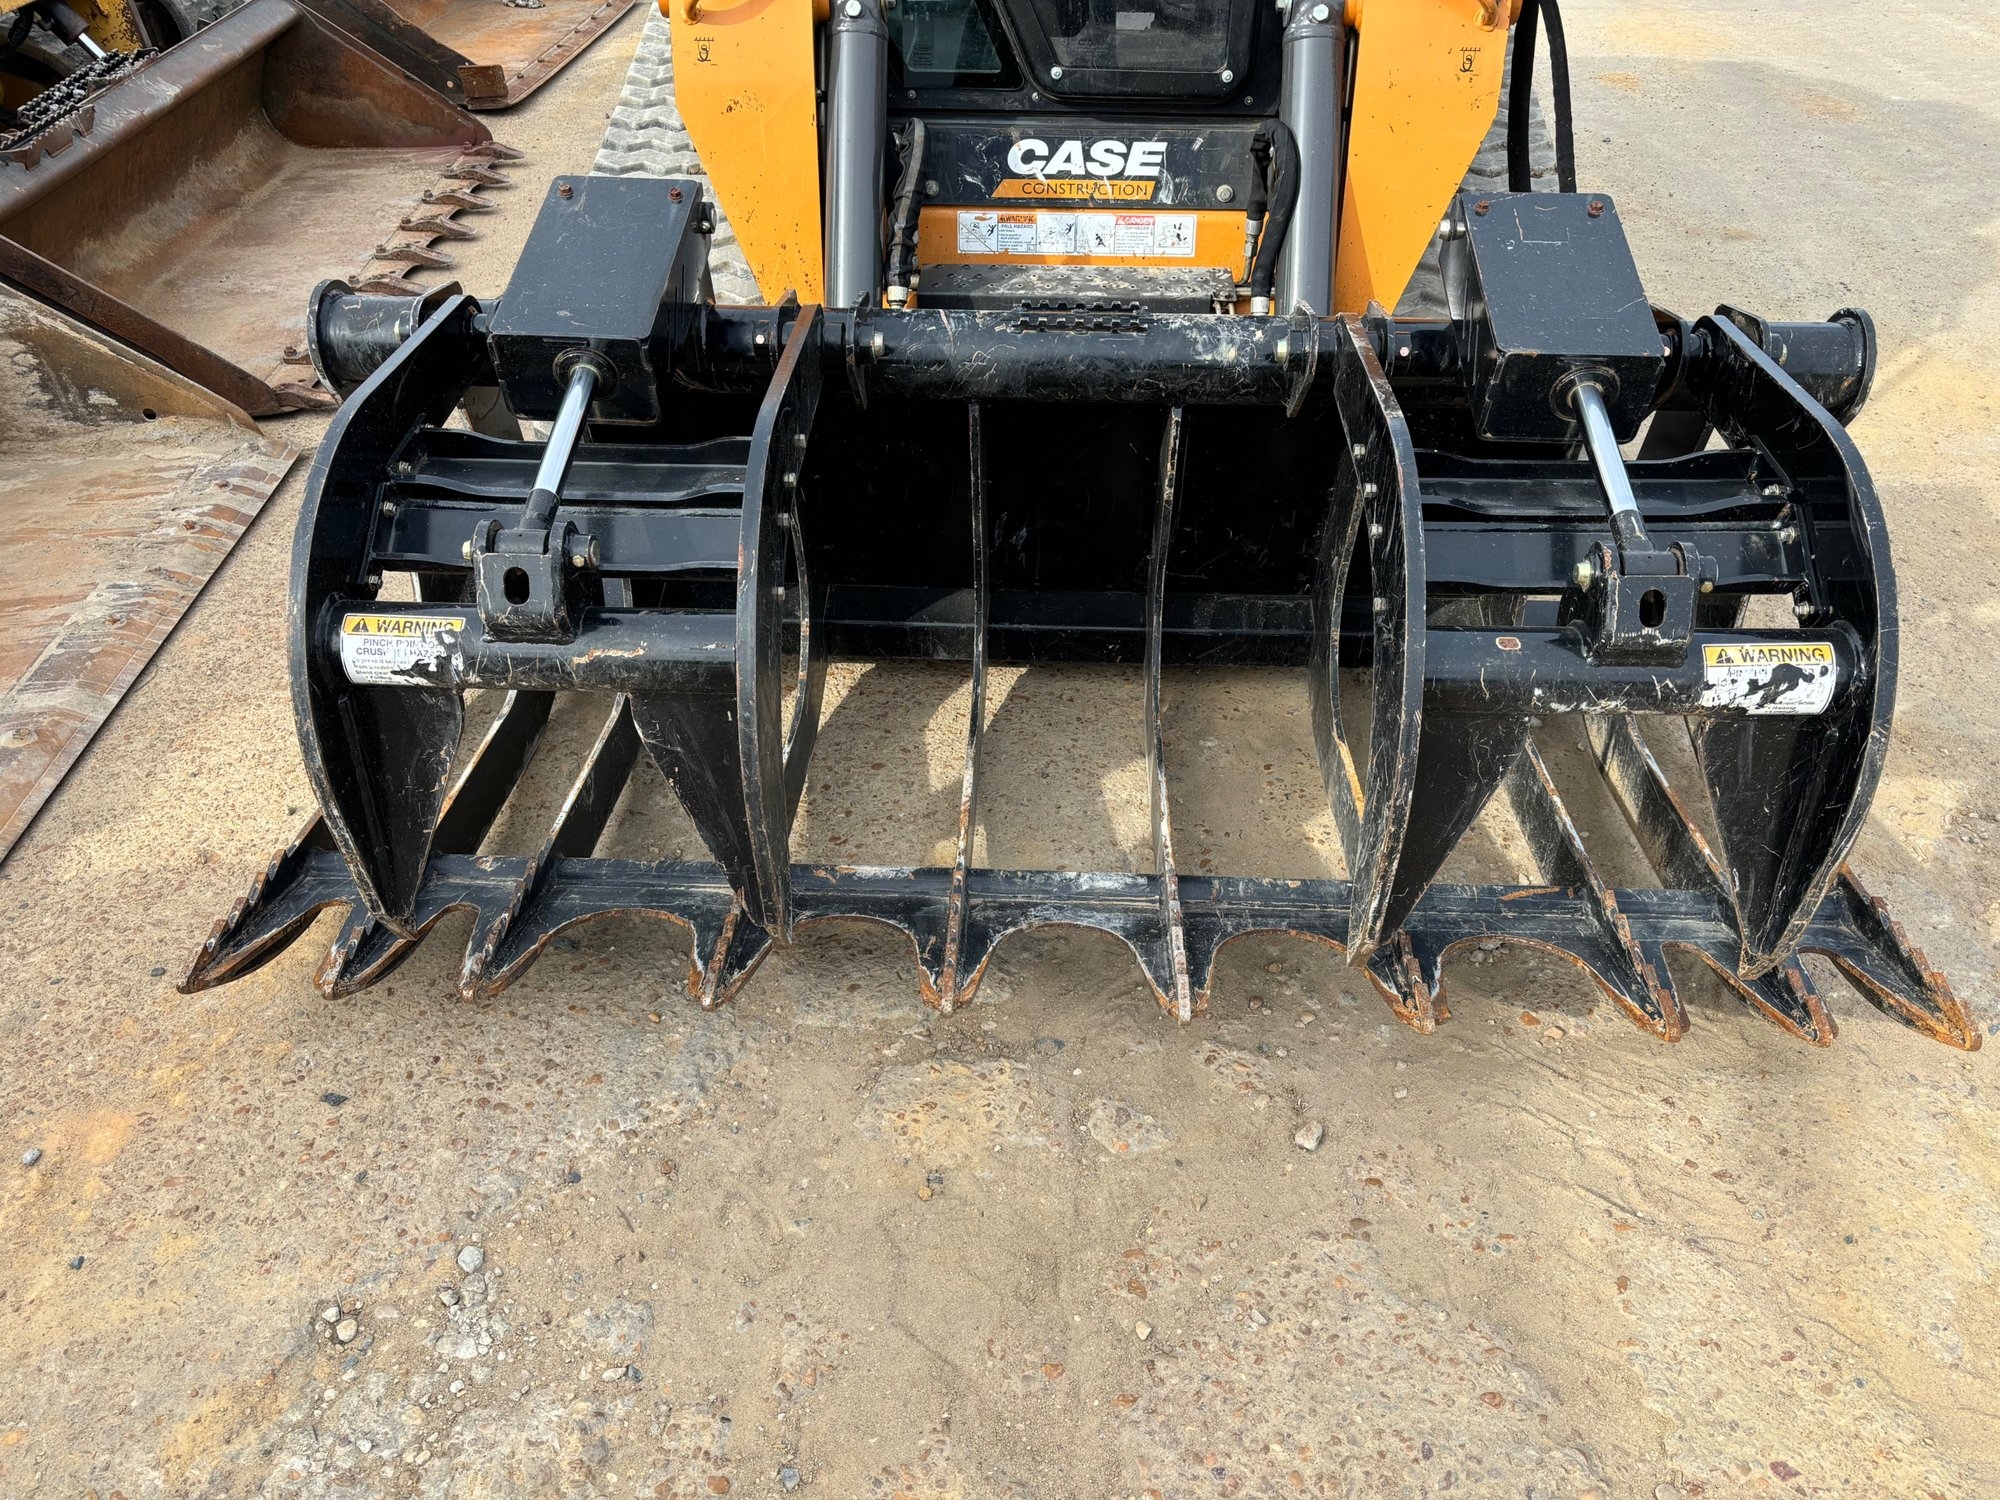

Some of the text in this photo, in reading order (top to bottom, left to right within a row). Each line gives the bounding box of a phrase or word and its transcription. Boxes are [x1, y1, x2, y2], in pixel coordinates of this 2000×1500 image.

[1007, 138, 1168, 177] CASE
[1021, 182, 1149, 197] CONSTRUCTION
[363, 638, 394, 648] PINCH
[1740, 647, 1825, 662] WARNING
